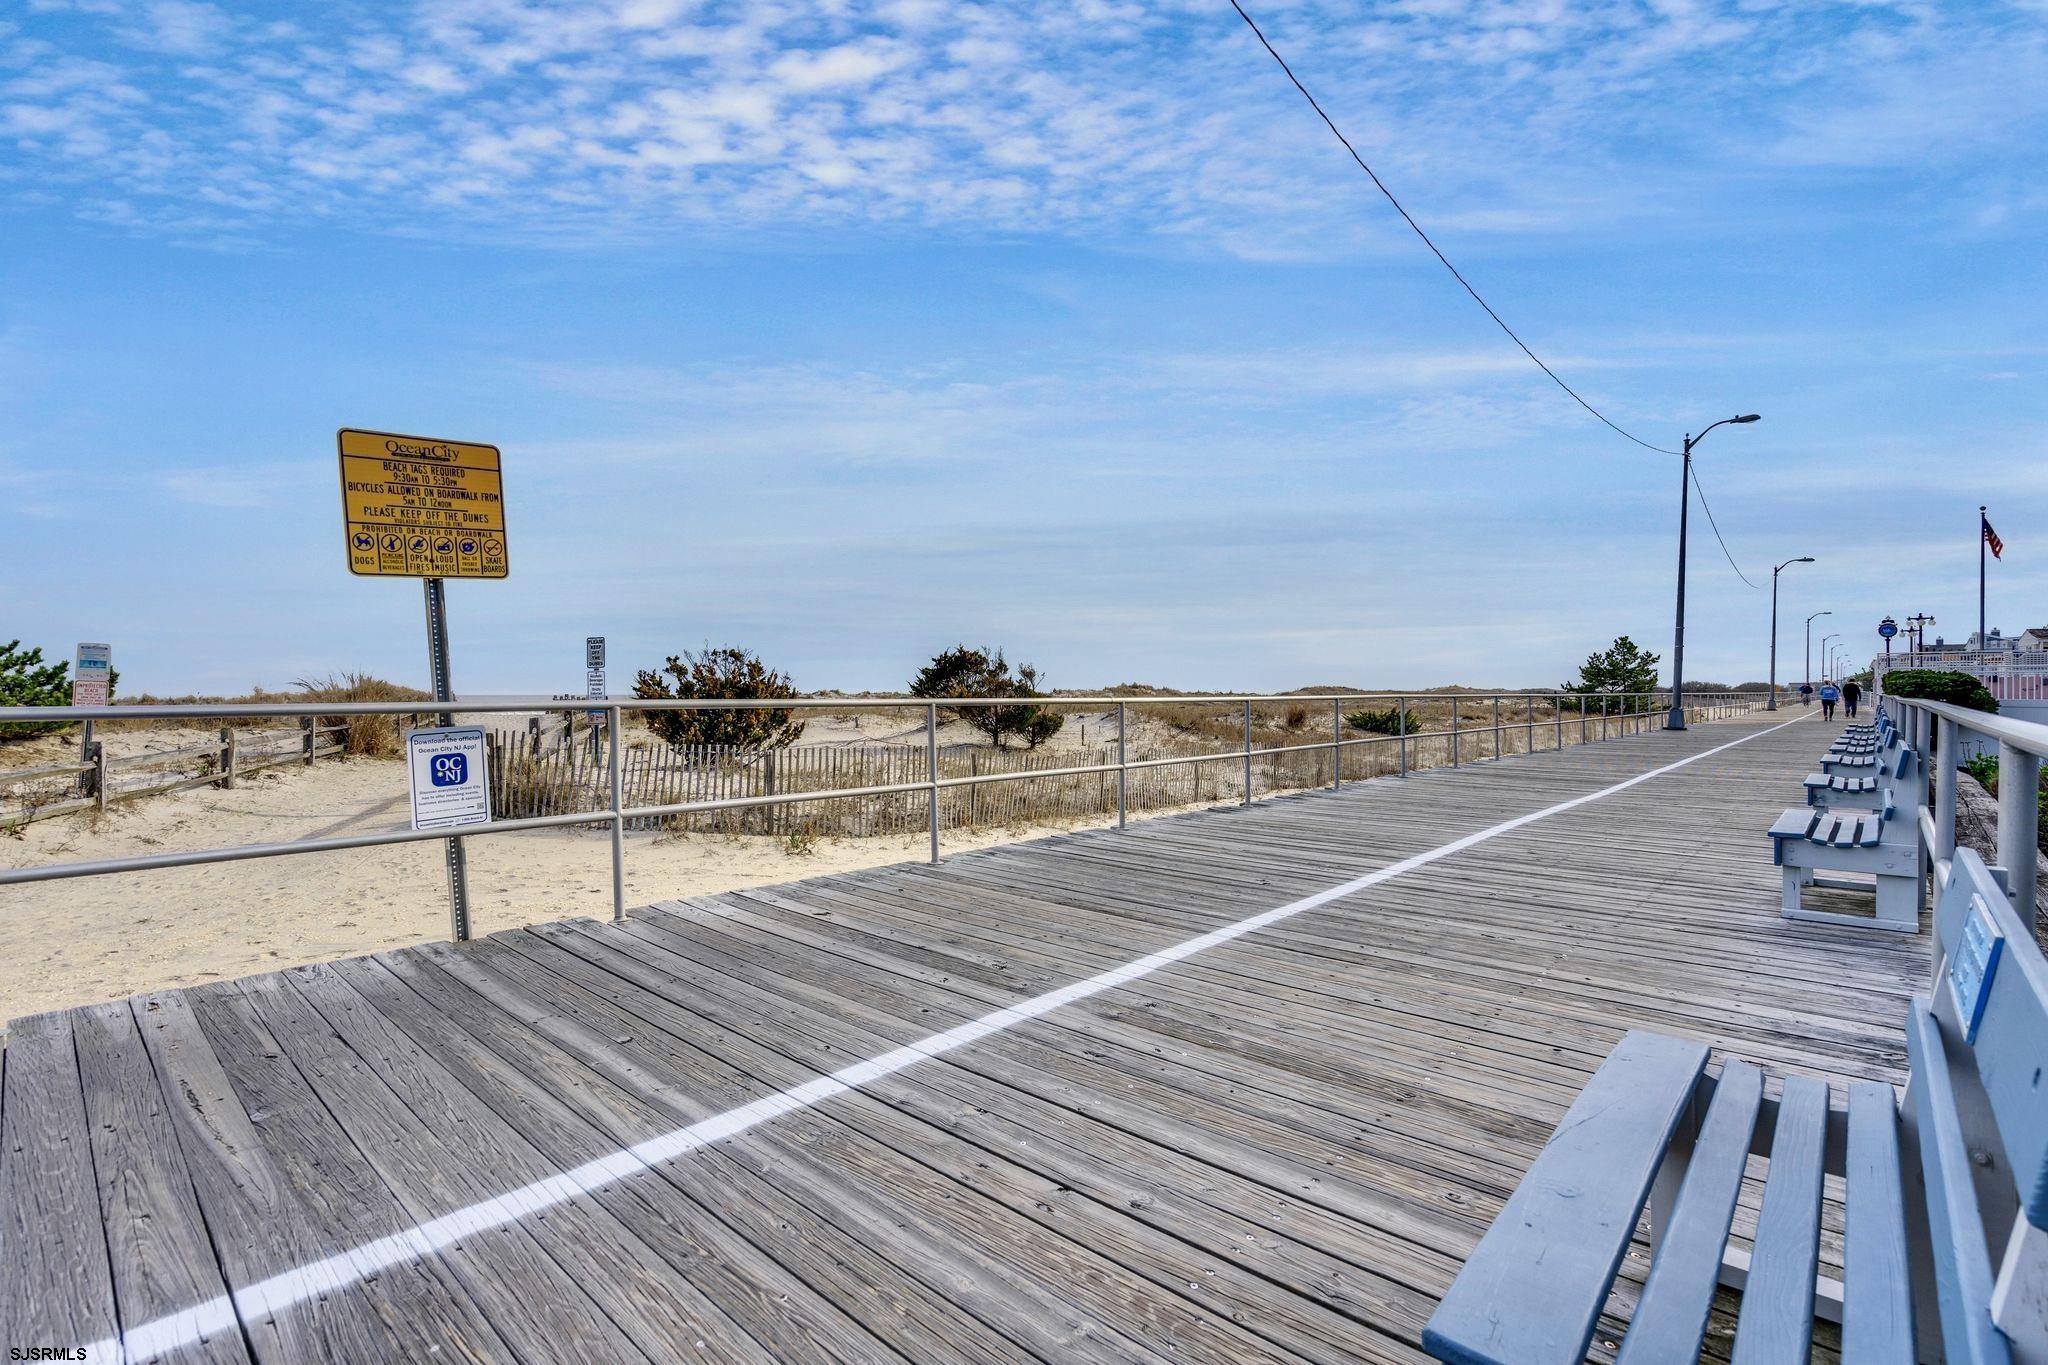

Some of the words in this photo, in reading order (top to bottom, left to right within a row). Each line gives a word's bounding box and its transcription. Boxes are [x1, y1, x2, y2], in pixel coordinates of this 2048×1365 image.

[383, 462, 407, 472] BEACH
[410, 464, 428, 475] TAGS
[431, 465, 465, 478] REQUIRED
[394, 472, 418, 483] 9:30AM
[421, 476, 430, 484] TO
[433, 476, 457, 486] 5:30PM
[348, 482, 384, 493] BICYCLES
[388, 485, 421, 496] ALLOWED
[424, 488, 434, 497] ON
[438, 488, 478, 501] BOARDWALK
[481, 493, 499, 502] FROM
[403, 497, 415, 506] 5AM
[418, 498, 426, 506] TO
[364, 507, 396, 517] PLEASE
[401, 509, 421, 519] KEEP
[426, 511, 440, 520] OFF
[444, 512, 458, 521] THE
[463, 513, 489, 523] DUNES
[362, 525, 403, 533] PROHIBITED
[420, 528, 440, 536] BEACH
[355, 557, 374, 565] DOGS
[410, 554, 429, 562] OPEN
[436, 555, 454, 563] LOUD
[486, 557, 502, 565] SKATE
[410, 563, 429, 571] FIRES
[435, 564, 456, 572] MUSIC
[436, 757, 462, 771] OC
[445, 769, 460, 783] NJ
